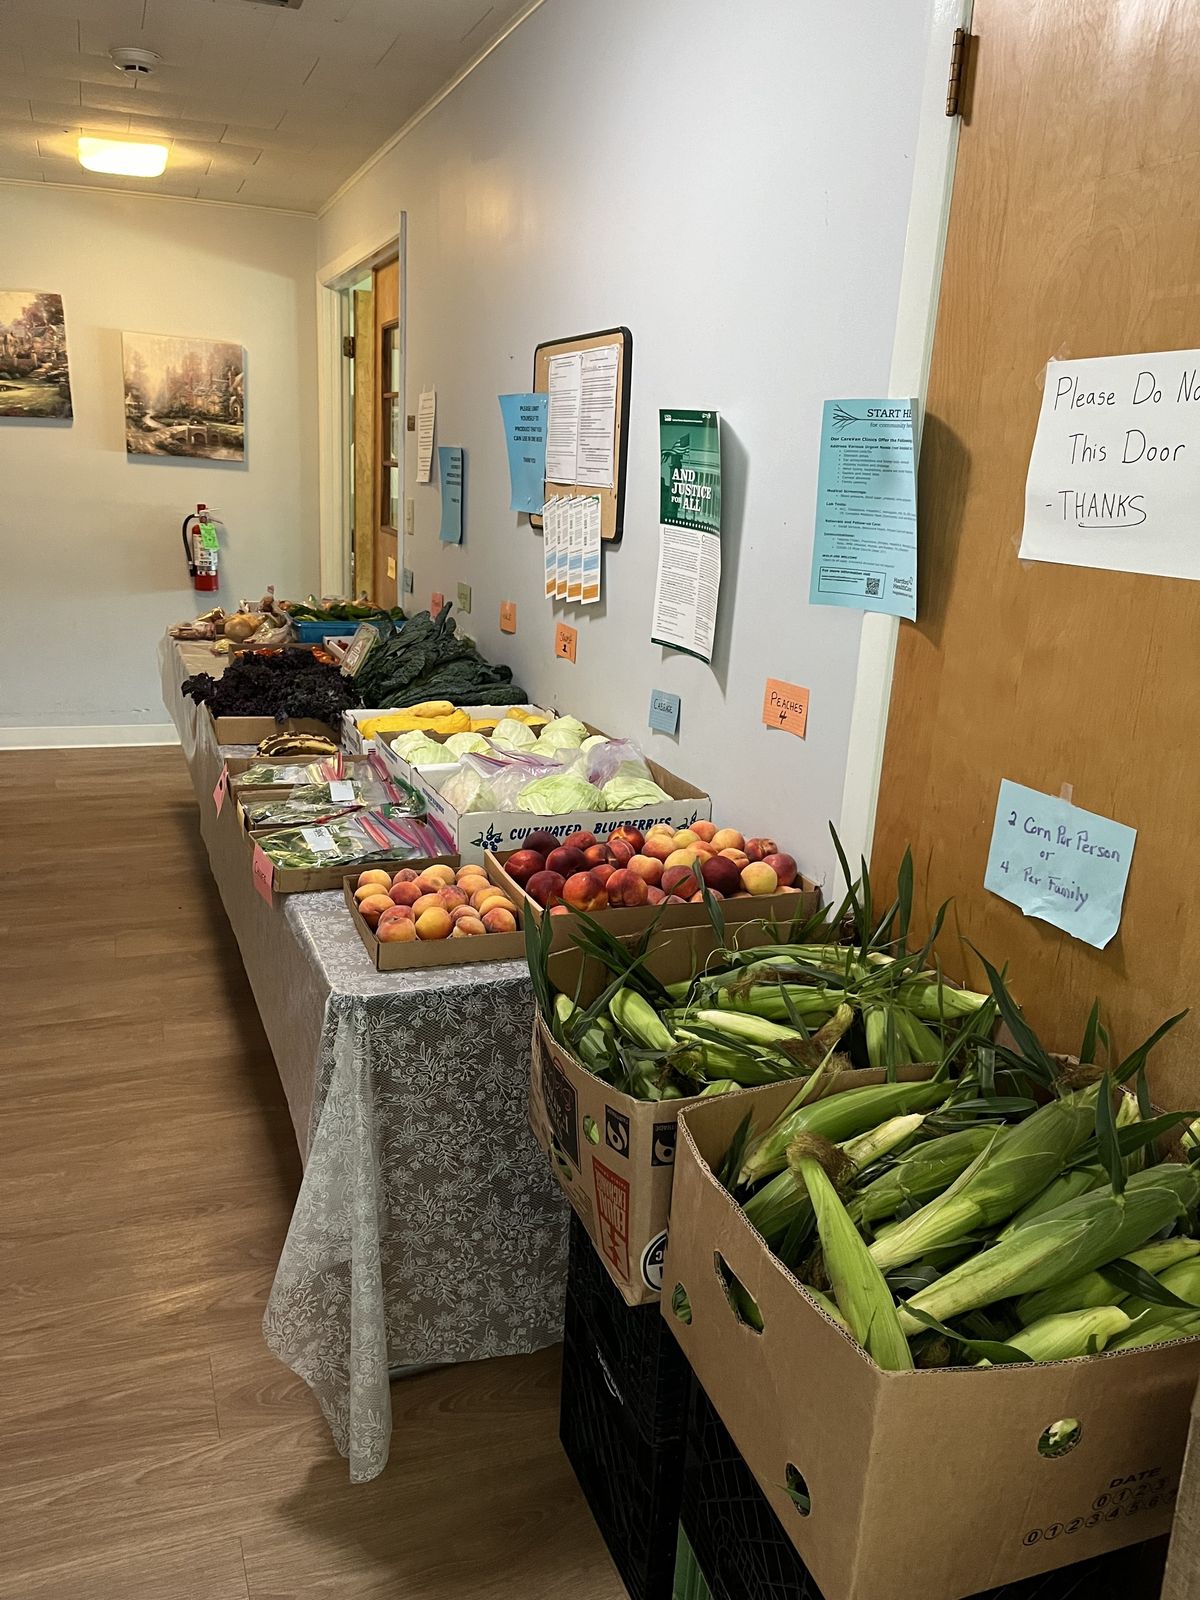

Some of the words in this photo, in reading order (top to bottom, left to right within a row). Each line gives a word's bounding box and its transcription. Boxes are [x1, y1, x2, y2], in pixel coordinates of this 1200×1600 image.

[1053, 375, 1117, 411] Please
[1132, 371, 1163, 406] Do
[866, 409, 901, 418] START
[1068, 433, 1107, 465] This
[1121, 429, 1187, 464] Door
[672, 468, 696, 482] AND
[671, 482, 712, 500] JUSTICE
[682, 497, 701, 512] ALL
[770, 691, 803, 714] PEACHES
[778, 710, 788, 725] 4
[1008, 811, 1017, 827] 2
[1023, 816, 1052, 842] Corn
[1075, 830, 1121, 863] Person
[1039, 850, 1056, 861] or
[1000, 860, 1010, 874] 4
[1023, 866, 1042, 886] Per
[1047, 875, 1089, 912] Family
[1109, 1466, 1162, 1489] DATE
